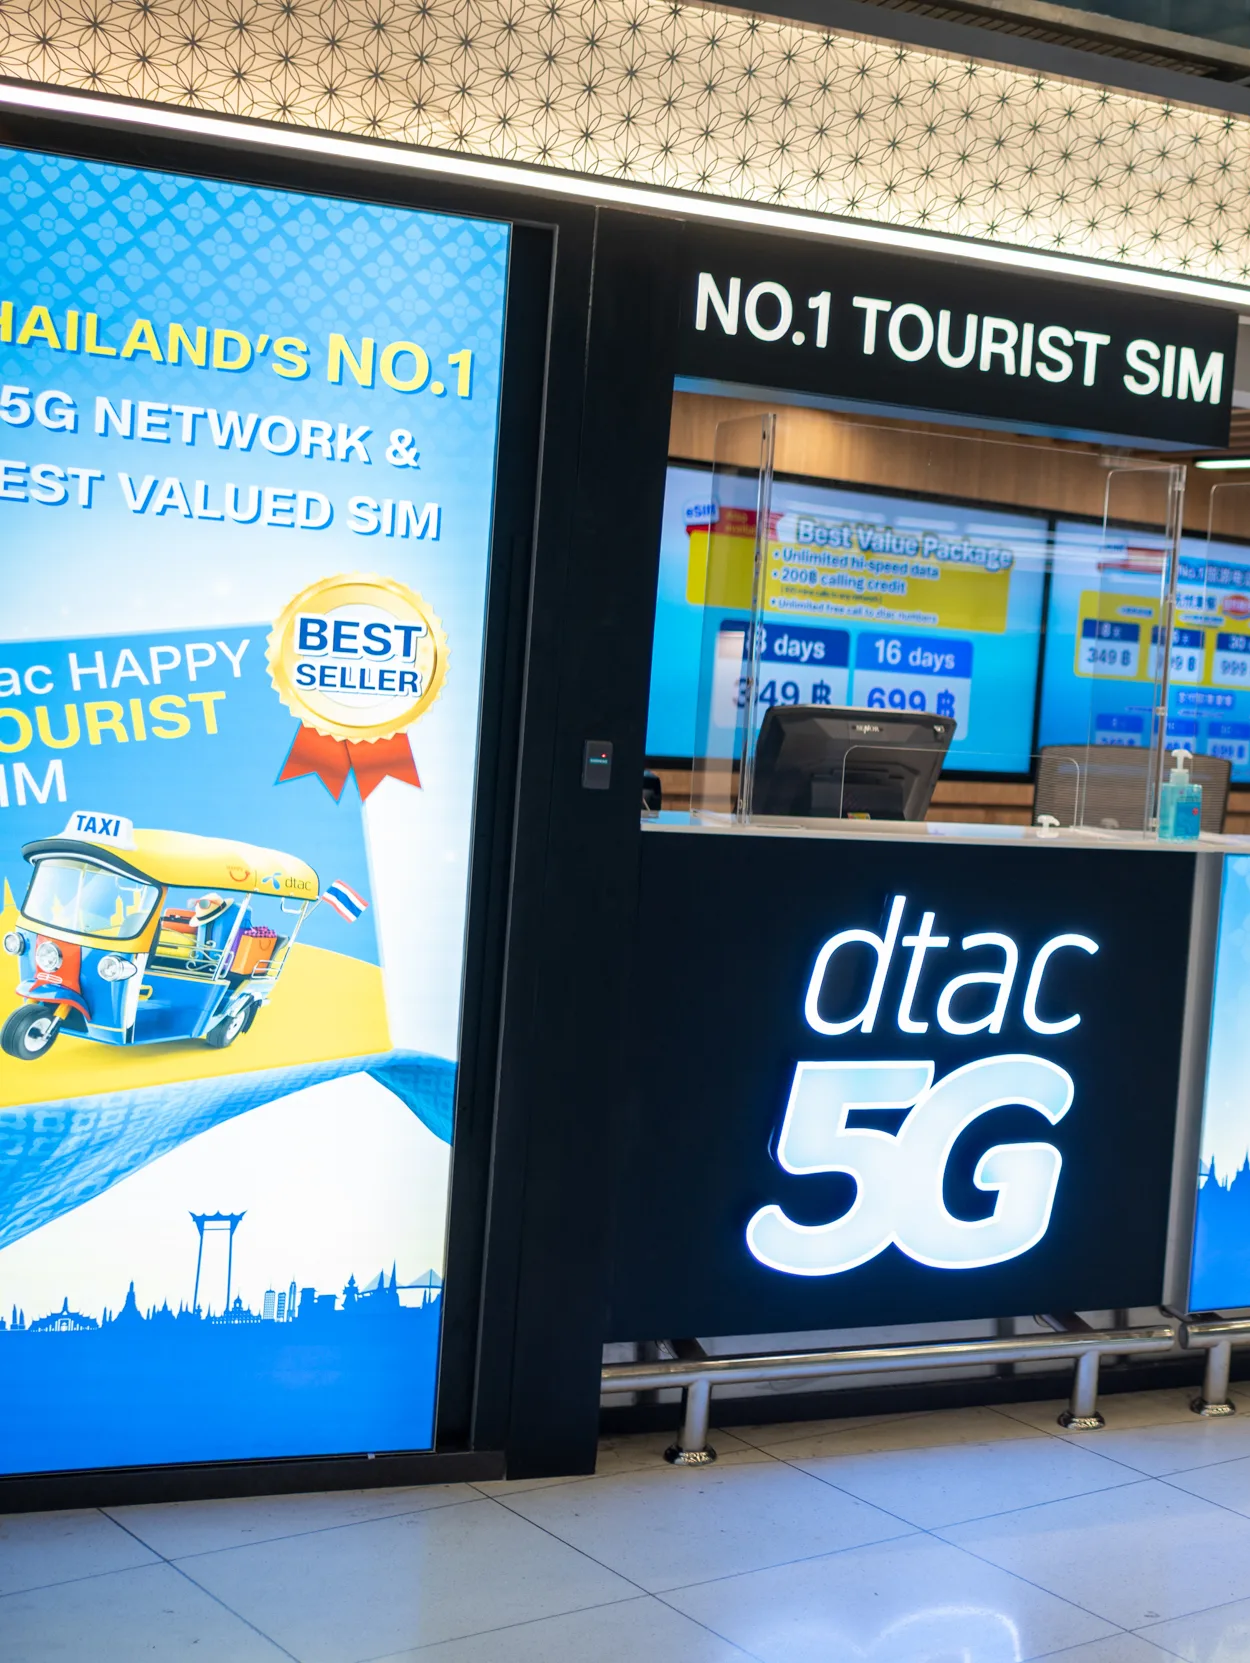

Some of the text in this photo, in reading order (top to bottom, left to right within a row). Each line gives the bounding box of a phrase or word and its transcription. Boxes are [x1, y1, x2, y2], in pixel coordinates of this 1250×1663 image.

[695, 271, 1225, 405] NO.1 TOURIST SIM
[326, 332, 475, 399] NO.1
[0, 383, 420, 468] 5G NETWORK &
[117, 470, 333, 529] VALUED
[346, 495, 442, 539] SIM
[781, 547, 940, 579] Unlimited hi-speed data
[796, 517, 1016, 572] Best Value Package
[820, 572, 865, 593] calling
[867, 578, 908, 595] credit
[297, 616, 426, 660] BEST
[773, 633, 827, 662] days
[874, 638, 956, 673] 16 days
[68, 637, 252, 692] HAPPY
[294, 661, 421, 694] SELLER
[75, 814, 121, 838] TAXI
[284, 876, 312, 891] dtac
[803, 894, 1100, 1036] dtac
[745, 1053, 1075, 1277] 5G
